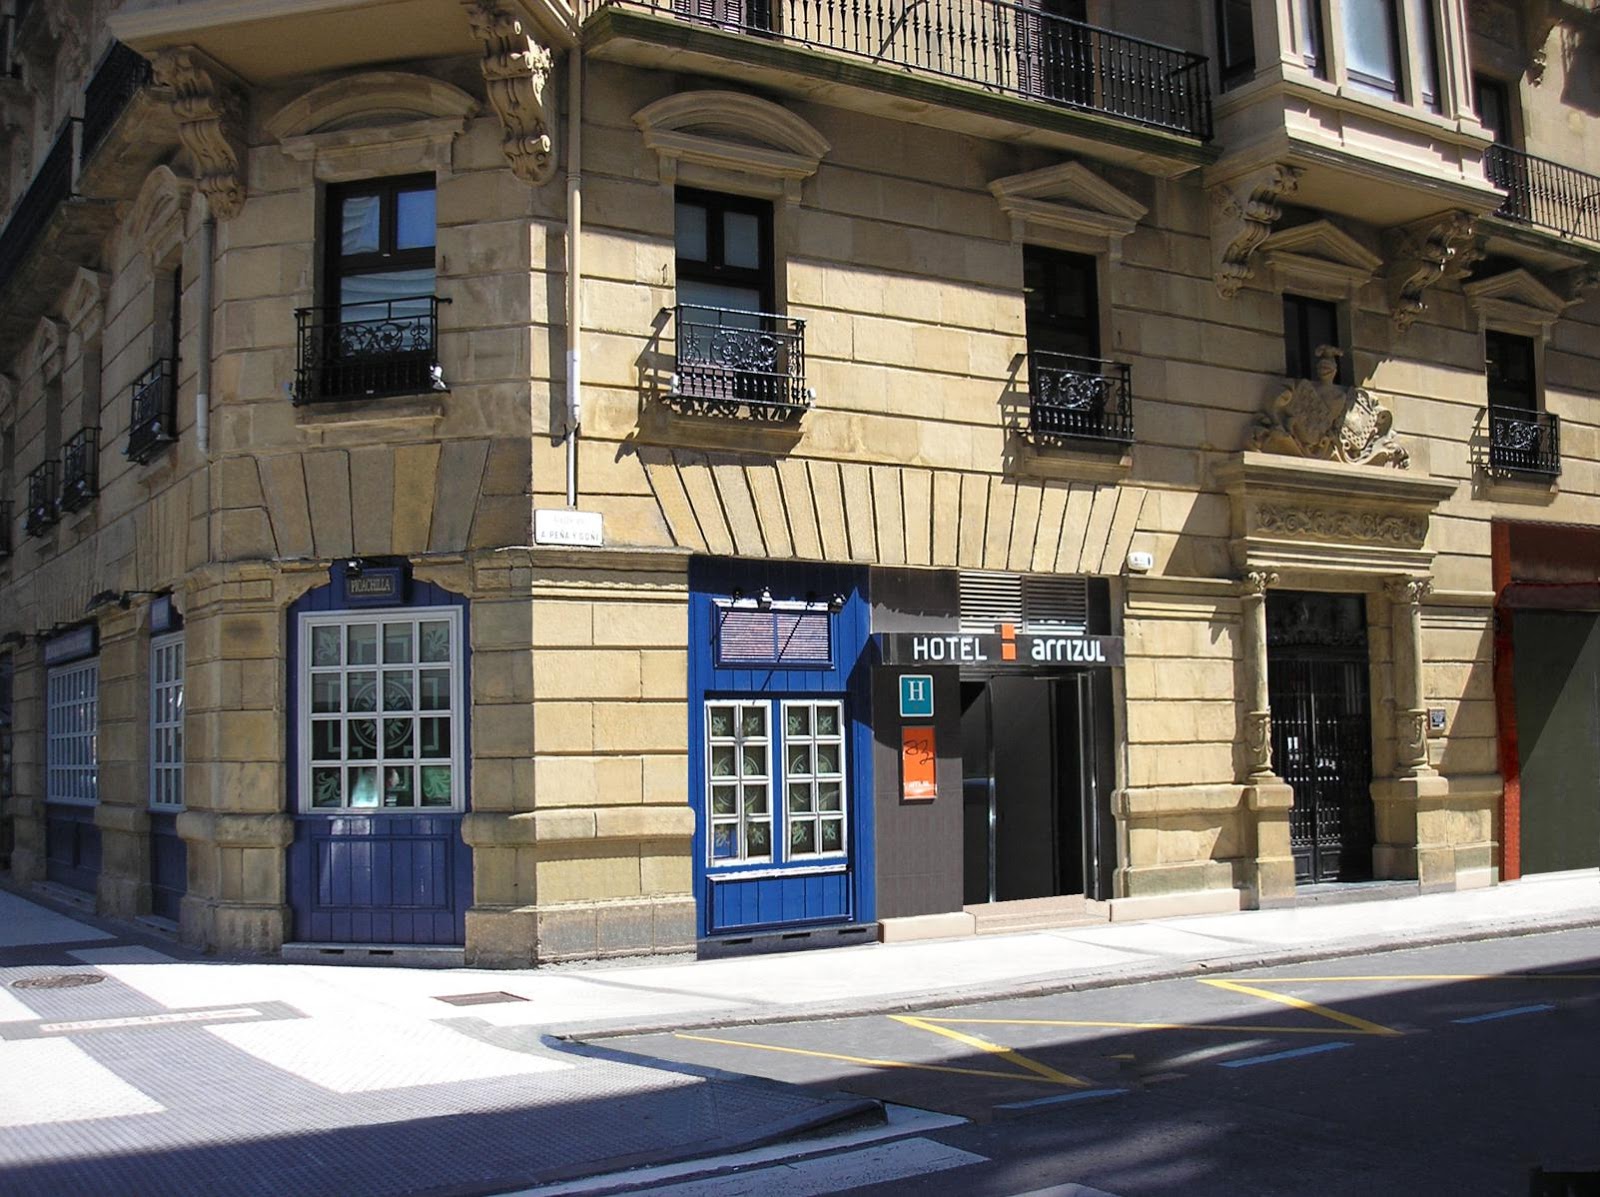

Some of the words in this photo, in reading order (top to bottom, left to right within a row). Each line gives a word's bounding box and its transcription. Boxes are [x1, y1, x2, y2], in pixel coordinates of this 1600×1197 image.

[549, 529, 569, 539] PEÑA
[913, 637, 987, 661] HOTEL
[908, 680, 925, 701] H
